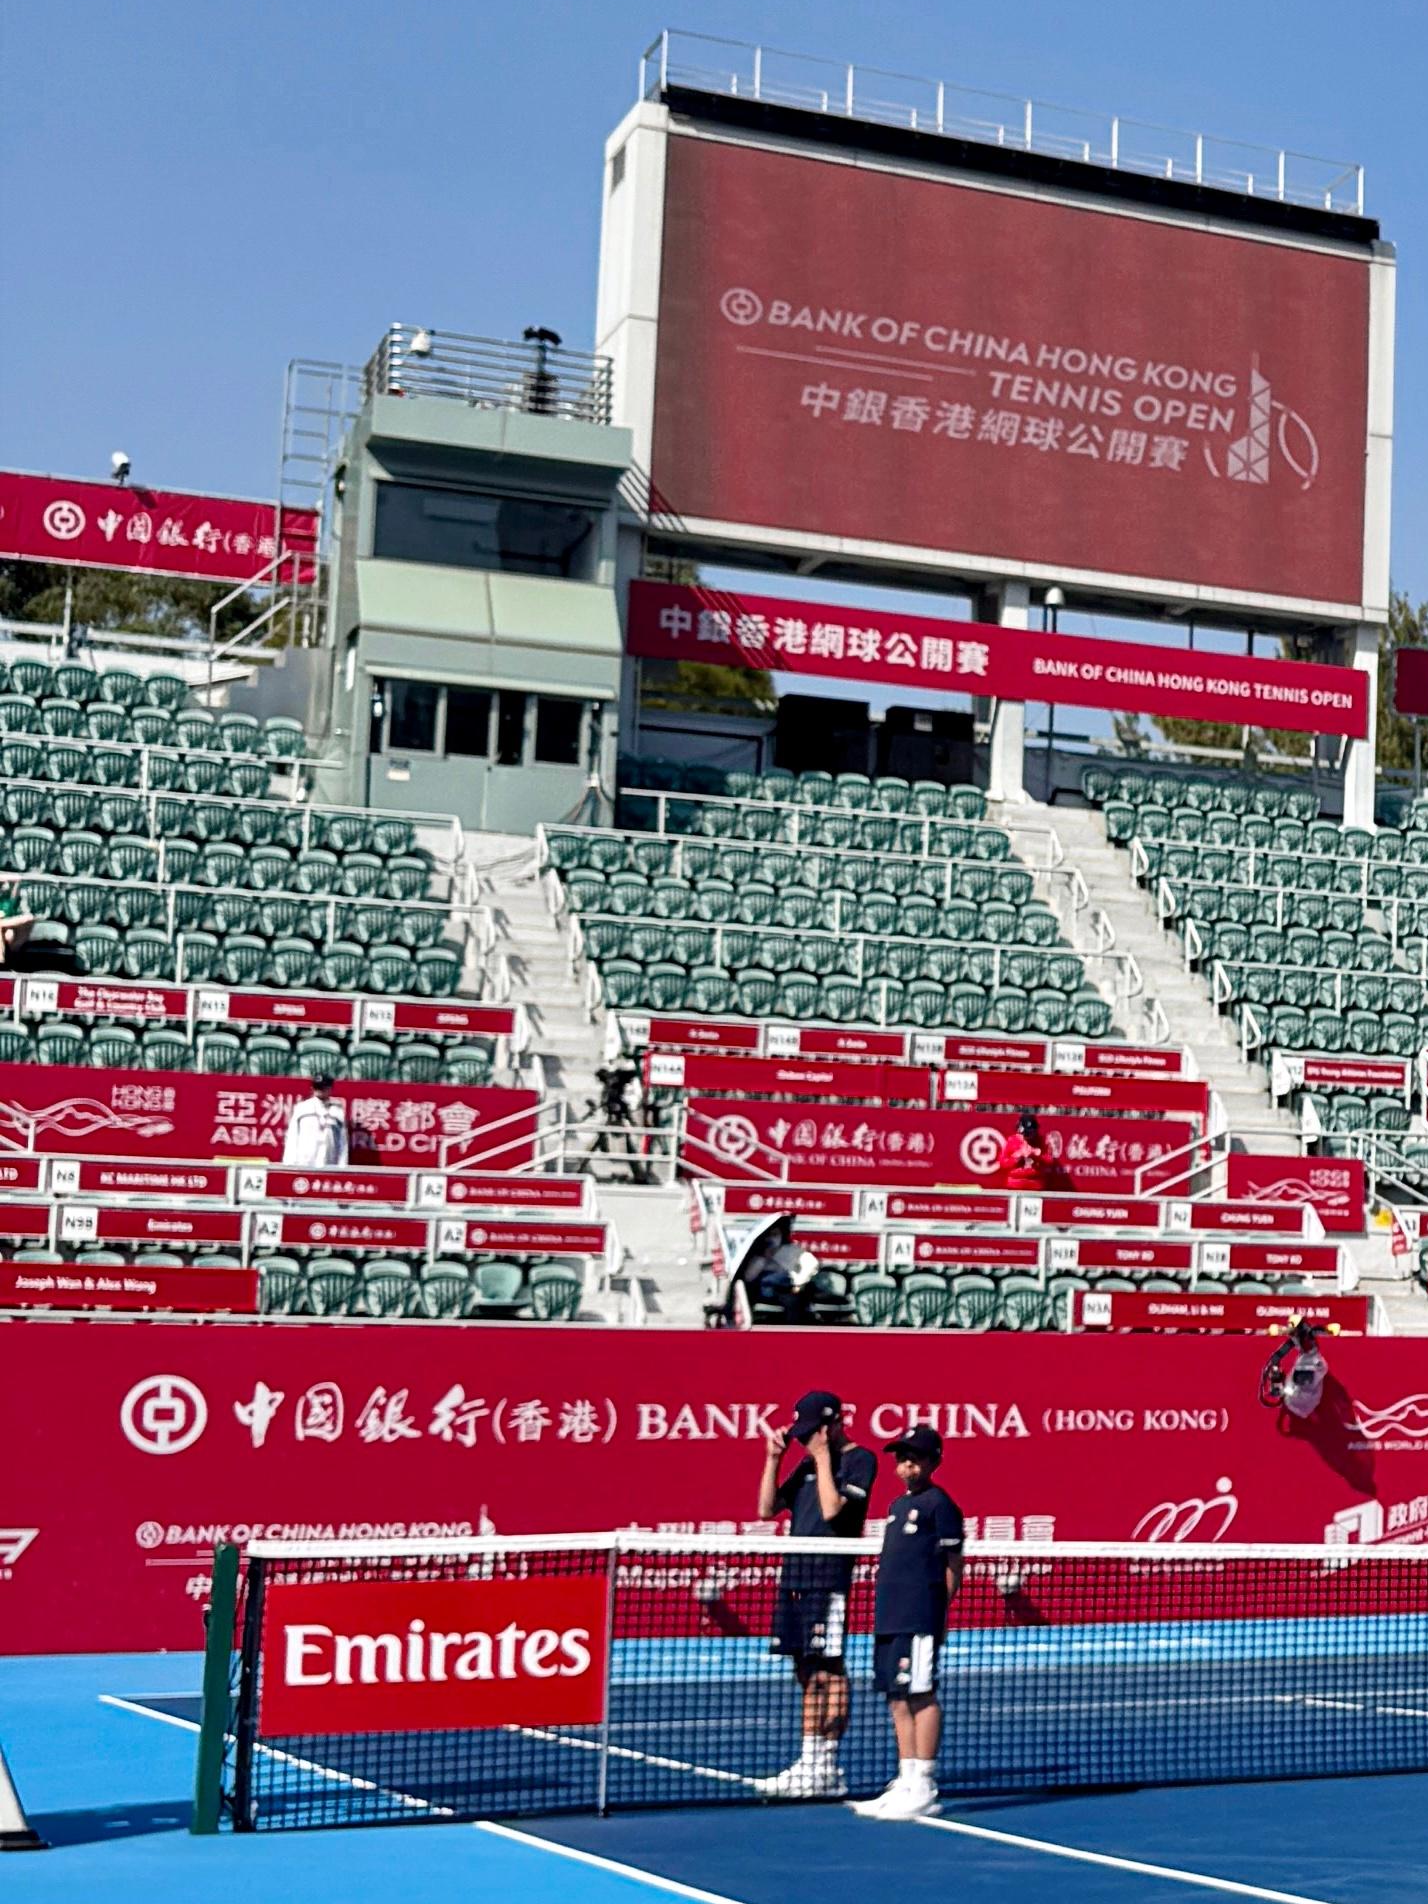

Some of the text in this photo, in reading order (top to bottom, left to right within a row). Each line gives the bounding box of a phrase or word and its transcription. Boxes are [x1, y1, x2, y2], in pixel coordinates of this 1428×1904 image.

[768, 300, 1237, 397] BANK OF CHINA HONG KONG
[800, 382, 1189, 472] 中銀香港網球公開賽
[989, 370, 1235, 433] TENNIS OPEN
[660, 604, 989, 677] 中銀香港網球公開賽
[1034, 658, 1353, 709] BANK OF CHINA HONG KONG TENNIS OPEN
[210, 1125, 286, 1147] ASIA'
[830, 1155, 875, 1168] CHINA
[636, 1402, 1229, 1440] BANK CHINA (HONG KONG)
[165, 1525, 233, 1545] BANK
[264, 1523, 334, 1540] CHINA
[338, 1523, 407, 1540] HONG
[407, 1522, 474, 1538] KONG
[283, 1618, 592, 1686] Emirates
